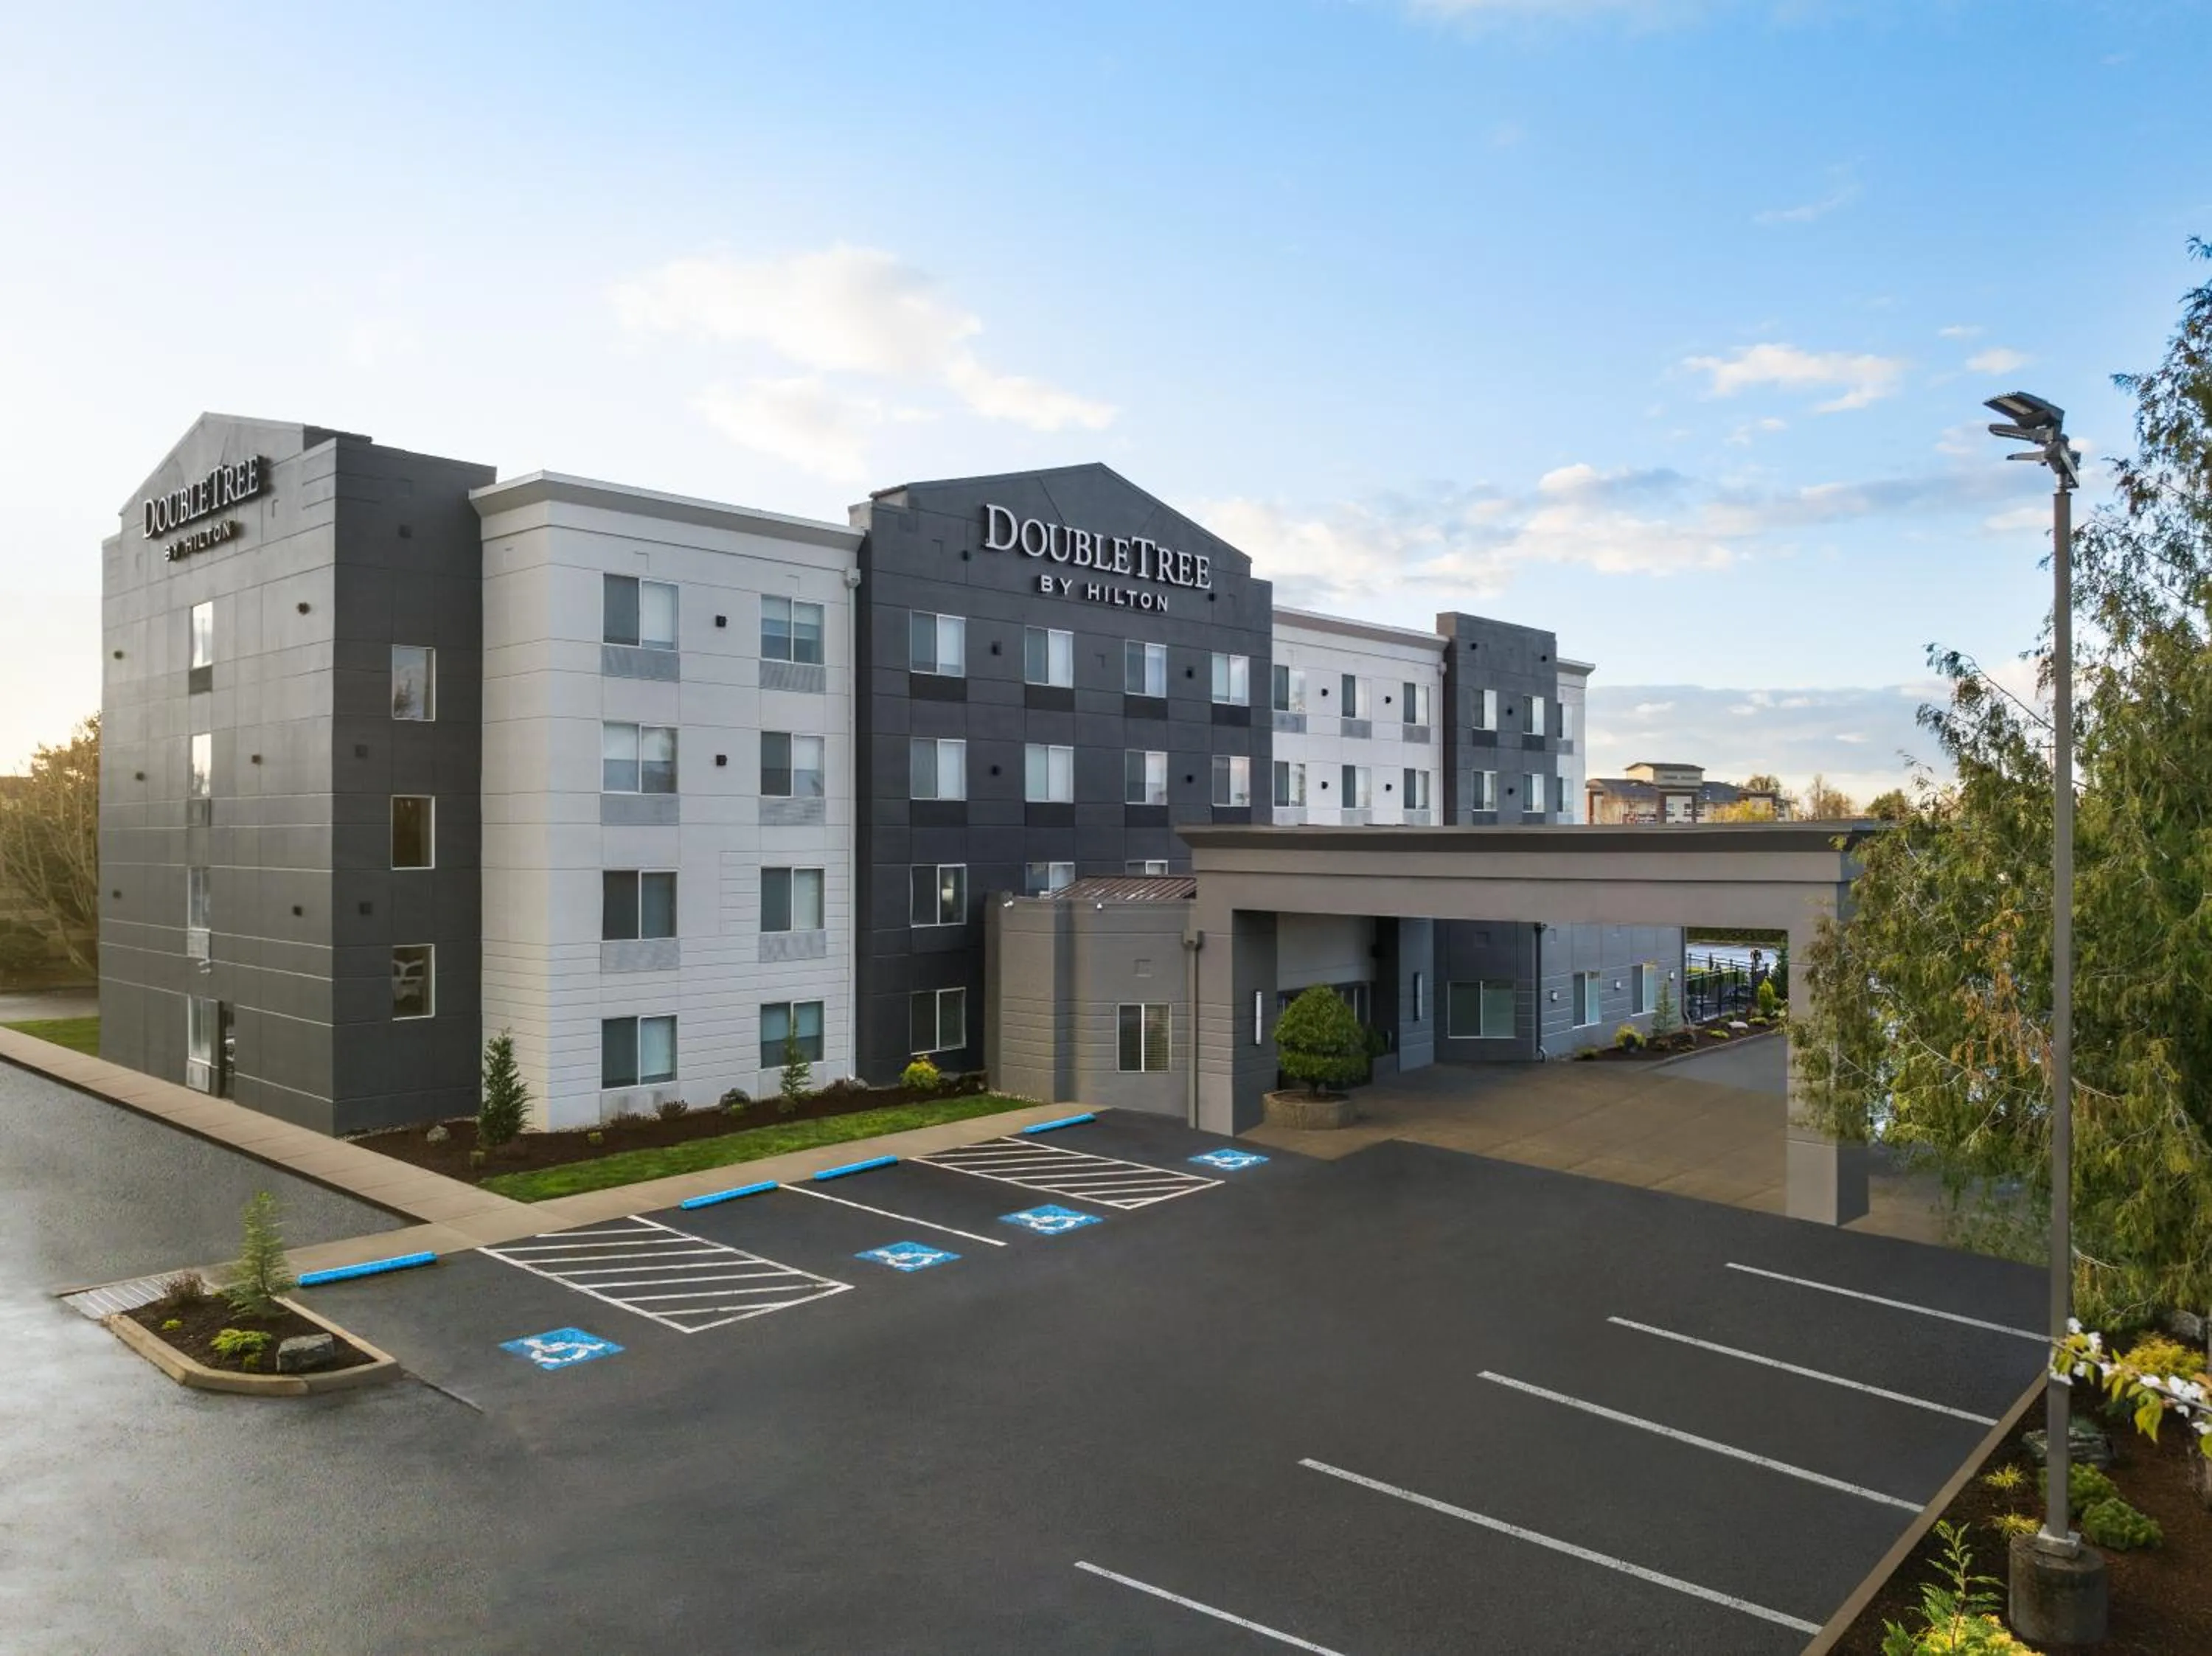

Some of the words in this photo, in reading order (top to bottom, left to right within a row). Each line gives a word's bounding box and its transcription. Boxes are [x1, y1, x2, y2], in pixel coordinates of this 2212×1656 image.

[142, 454, 259, 539] DOUBLETREE
[164, 543, 178, 561] BY
[186, 519, 231, 553] HILTON
[985, 504, 1211, 589] DOUBLETREE
[1040, 574, 1073, 595] BY
[1088, 583, 1168, 612] HILTON
